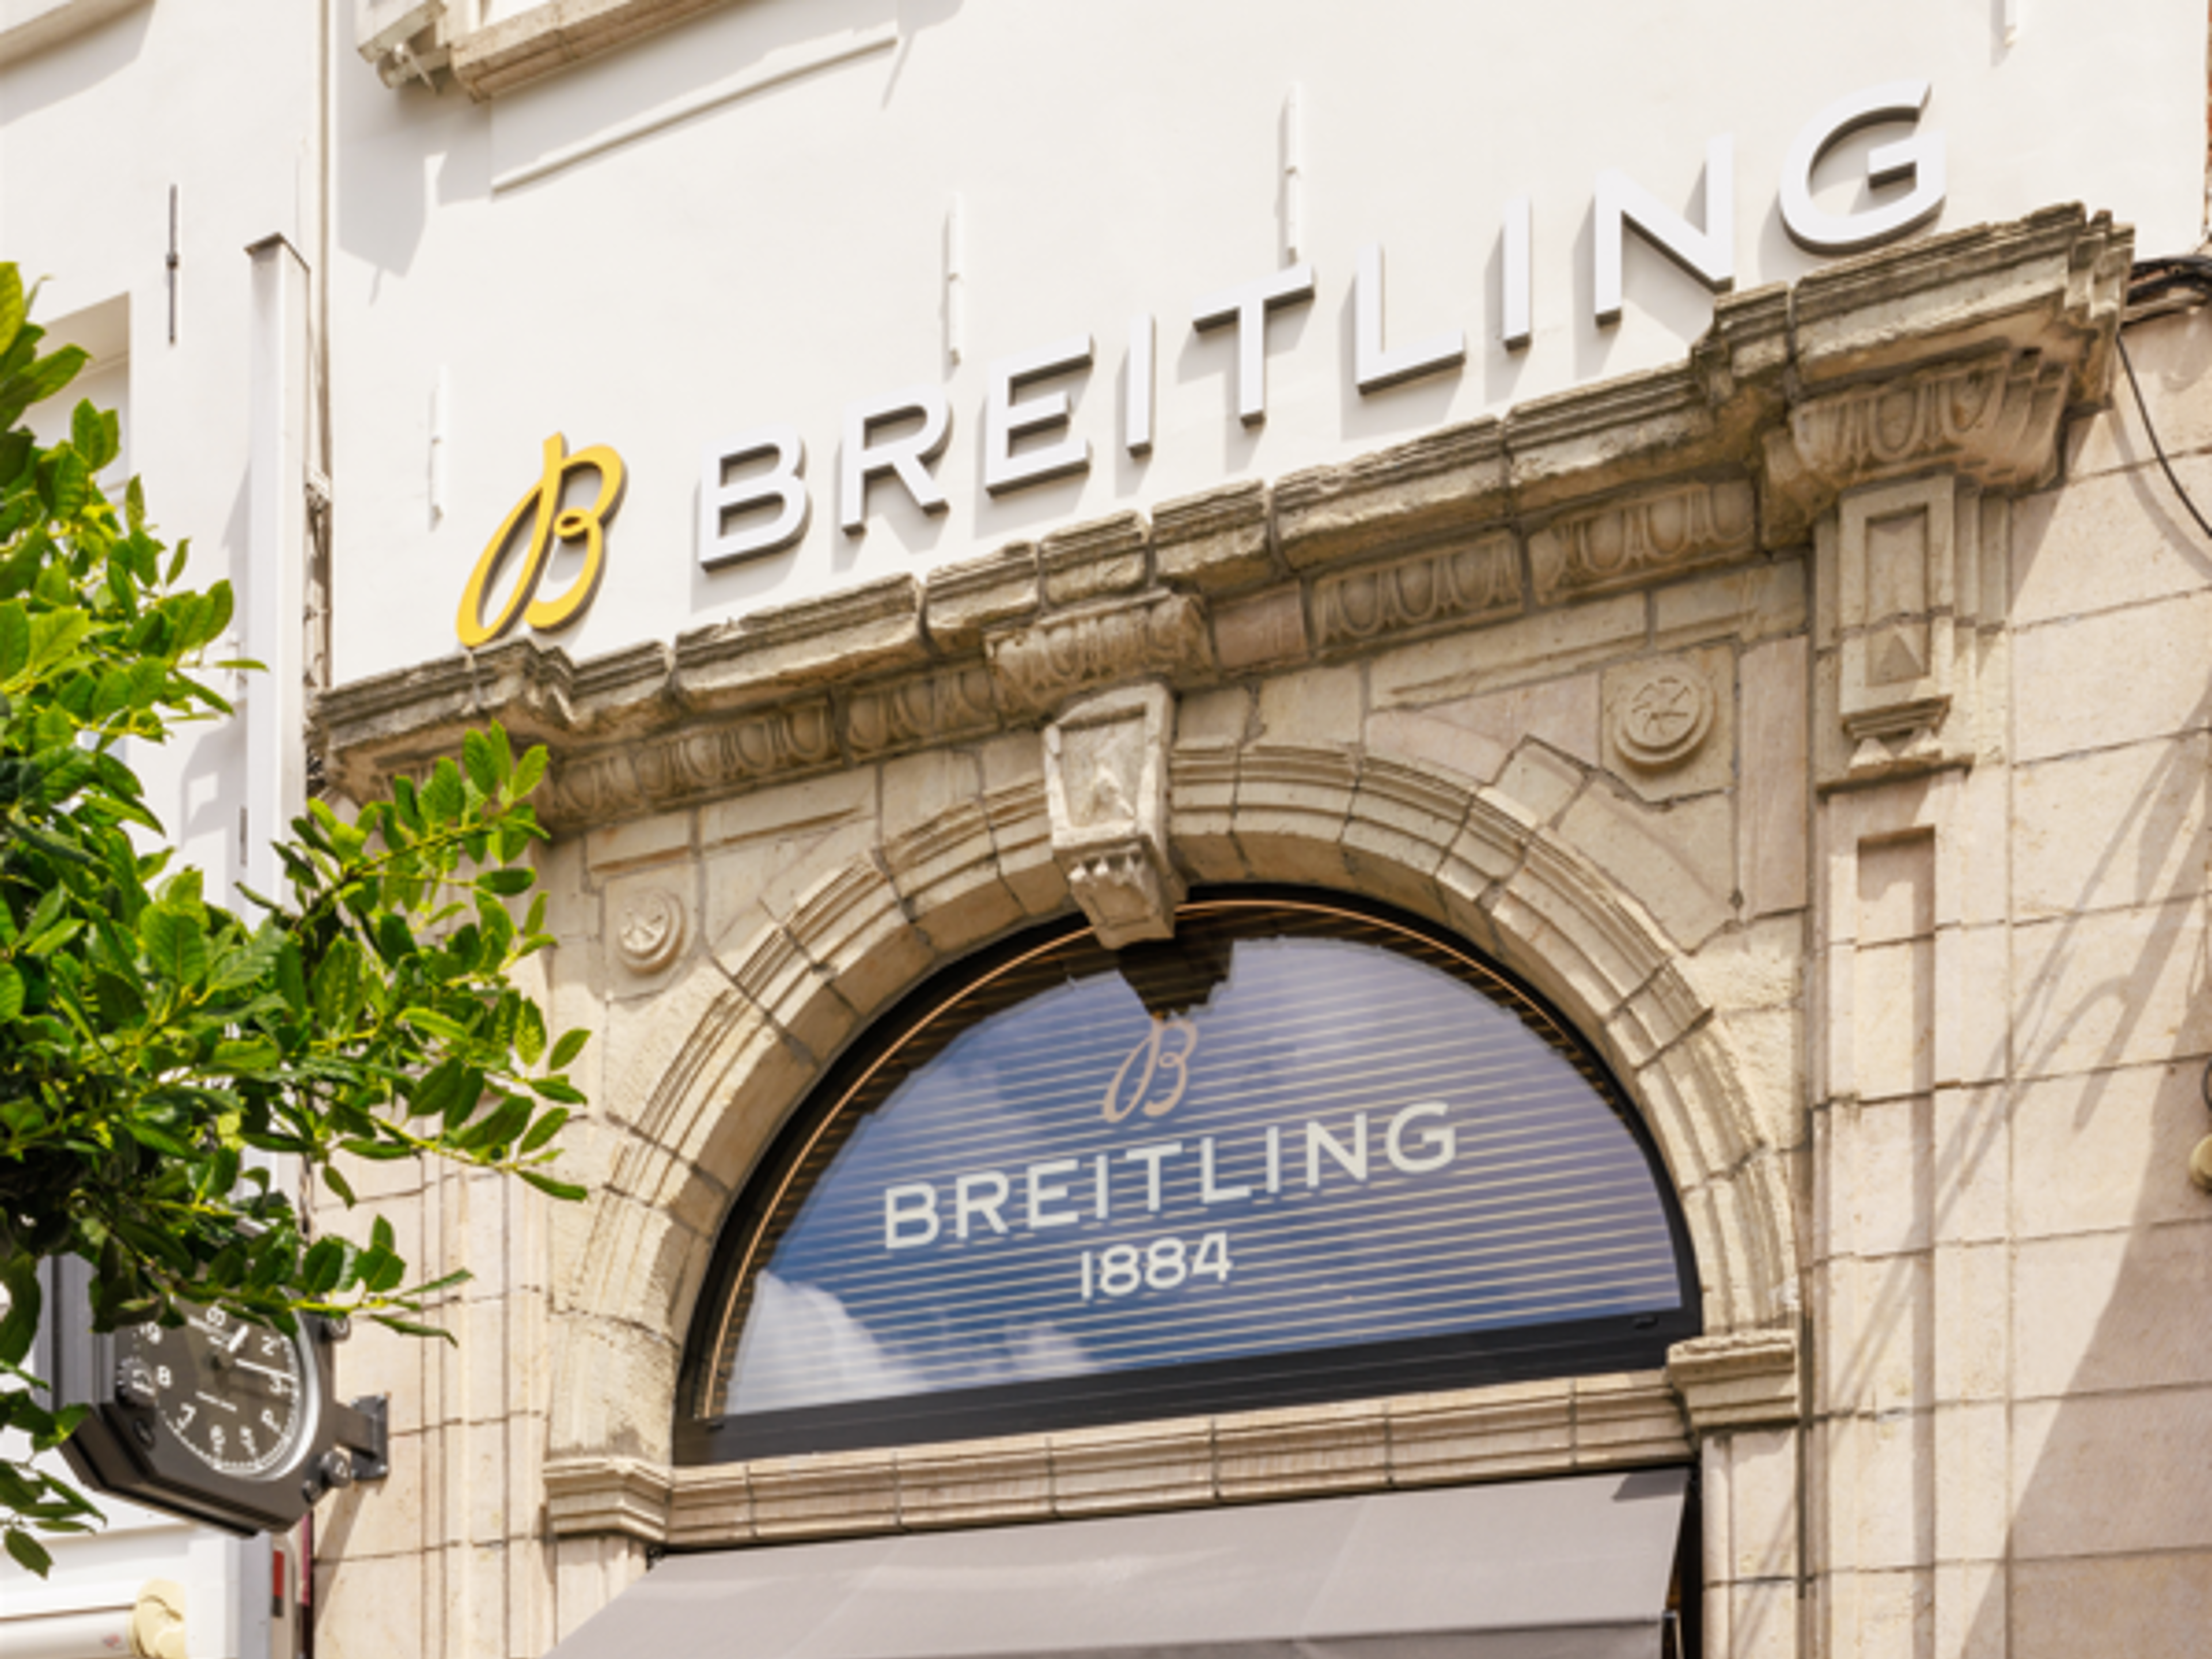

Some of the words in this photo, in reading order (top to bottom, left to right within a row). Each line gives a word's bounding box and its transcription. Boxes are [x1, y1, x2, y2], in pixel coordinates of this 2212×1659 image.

[697, 82, 1947, 571] BREITLING
[884, 1101, 1457, 1249] BREITLING
[1081, 1230, 1233, 1301] 1884
[157, 1364, 172, 1389] 8
[261, 1335, 275, 1356] 2
